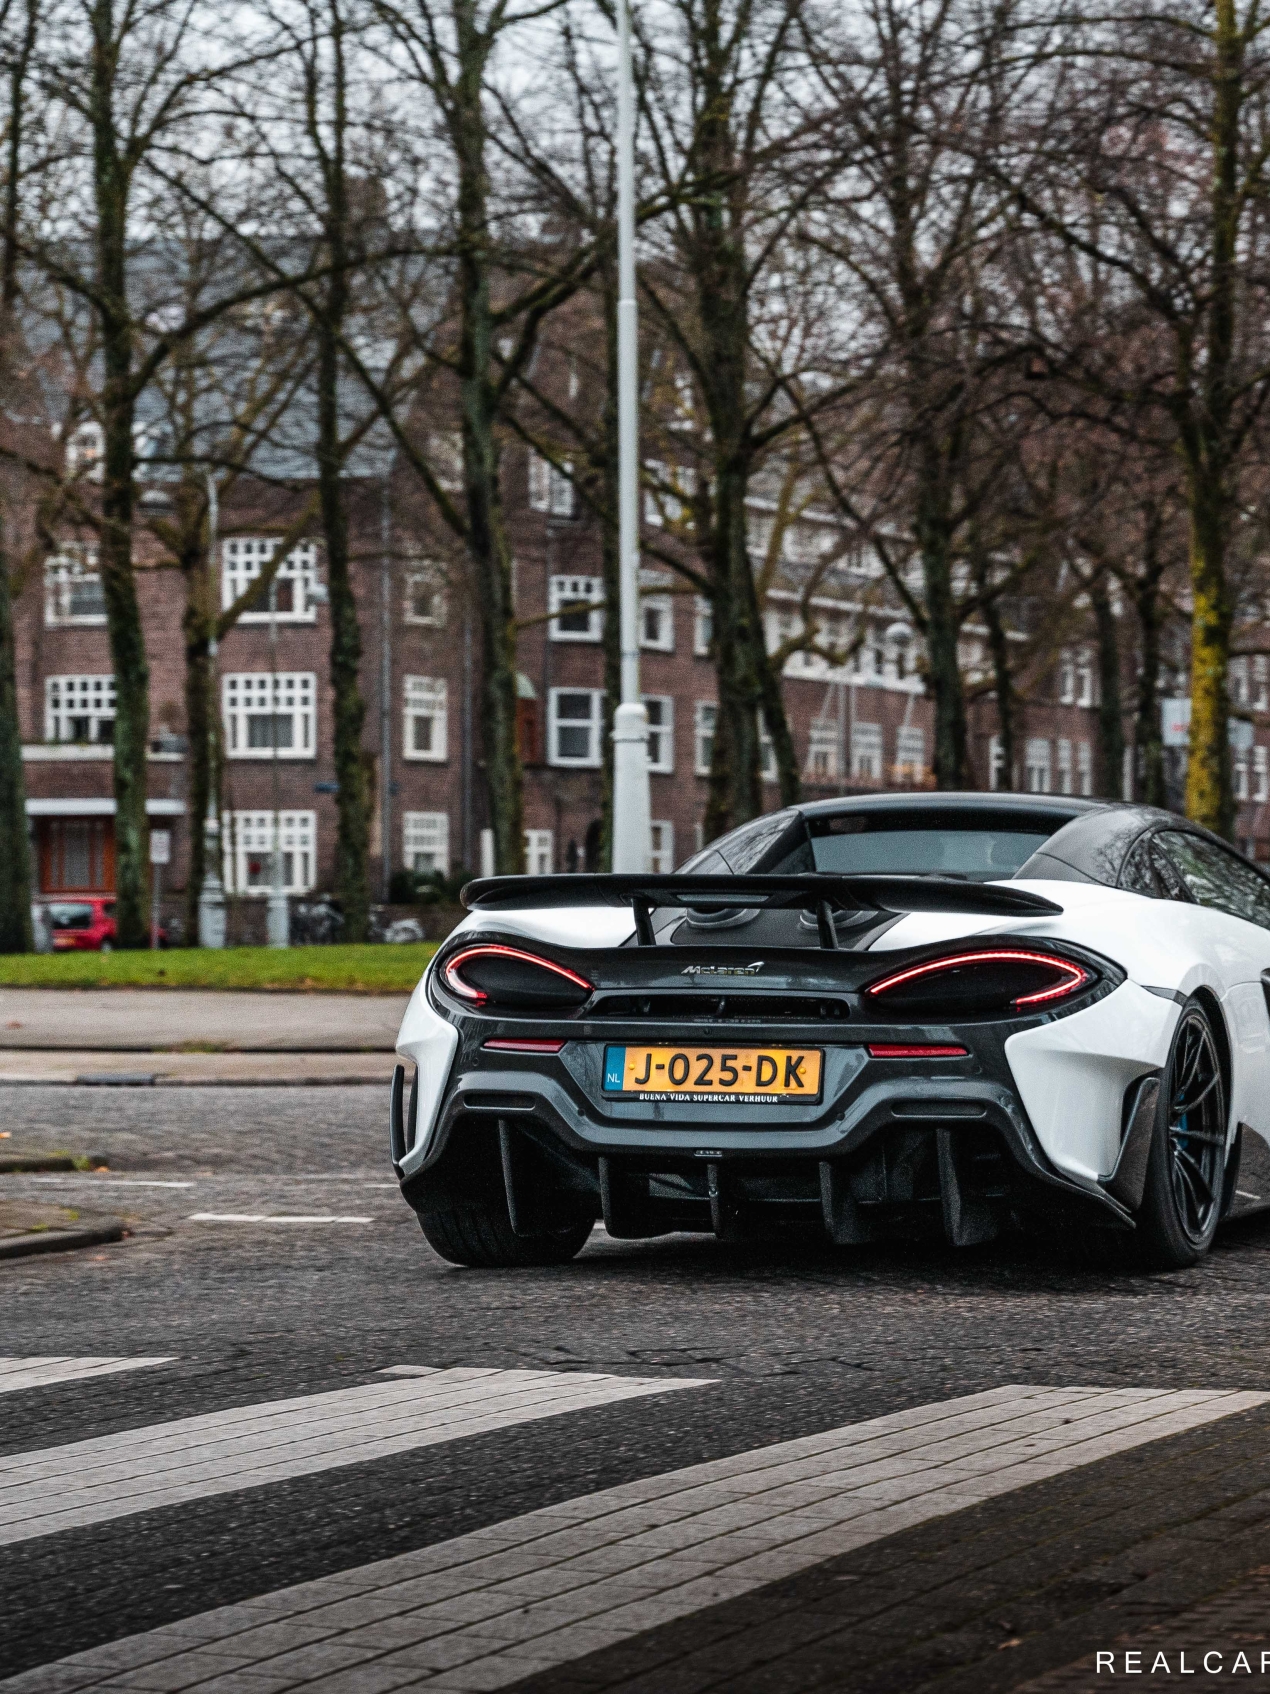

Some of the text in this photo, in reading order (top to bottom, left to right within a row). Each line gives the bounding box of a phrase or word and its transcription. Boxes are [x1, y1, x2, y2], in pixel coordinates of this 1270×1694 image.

[634, 1053, 805, 1088] J-025-DK
[607, 1073, 621, 1083] NL
[639, 1093, 779, 1103] BUENA VIDA SUPERCAR VERHUUR
